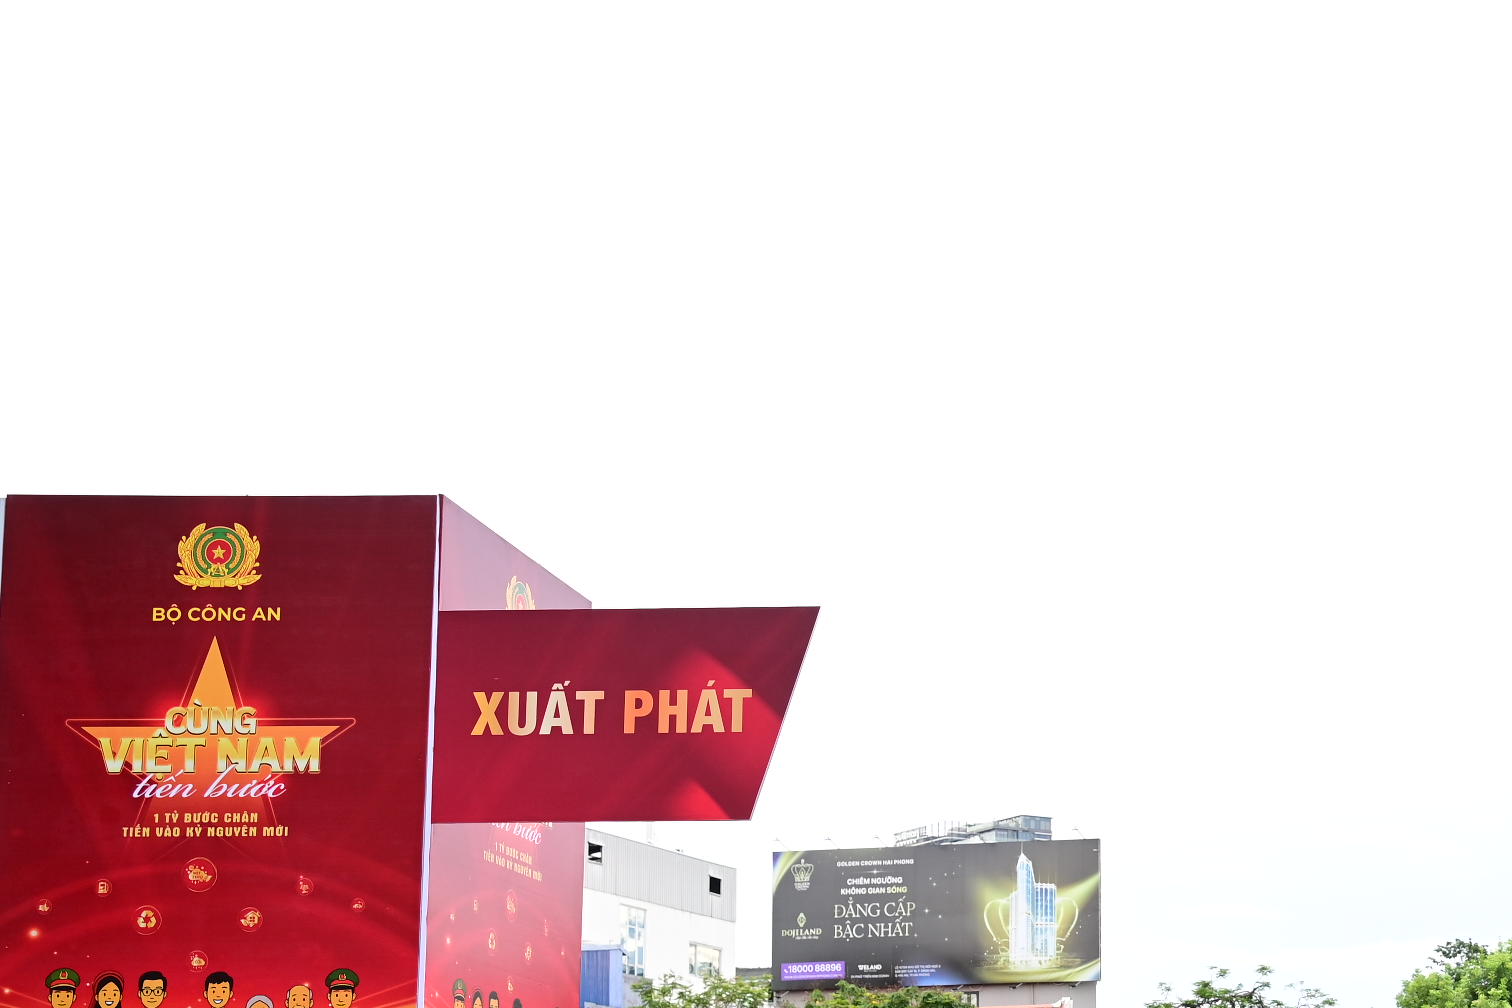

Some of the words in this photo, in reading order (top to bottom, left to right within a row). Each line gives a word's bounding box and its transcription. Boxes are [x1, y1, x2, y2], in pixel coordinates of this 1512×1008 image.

[152, 603, 182, 625] BỘ
[187, 603, 246, 622] CÔNG
[252, 606, 282, 622] AN
[165, 700, 258, 735] CÙNG
[470, 680, 605, 736] XUẤT
[623, 680, 753, 734] PHÁT
[99, 729, 207, 780] VIỆT
[216, 737, 321, 774] NAM
[133, 769, 197, 799] tiến
[204, 764, 287, 799] bước
[154, 814, 159, 823] 1
[184, 812, 219, 823] BƯỚC
[224, 811, 258, 823] CHÂN
[122, 825, 150, 837] TIẾN
[156, 824, 181, 837] VÀO
[207, 824, 257, 837] NGUYÊN
[262, 825, 289, 837] MỚI
[861, 859, 882, 867] CROWN
[894, 858, 914, 866] PHONG
[840, 886, 867, 895] KHÔNG
[884, 896, 916, 917] CẤP
[834, 921, 864, 941] BẬC
[868, 917, 913, 938] NHẤT
[788, 964, 813, 974] 18000
[815, 963, 842, 973] 88896
